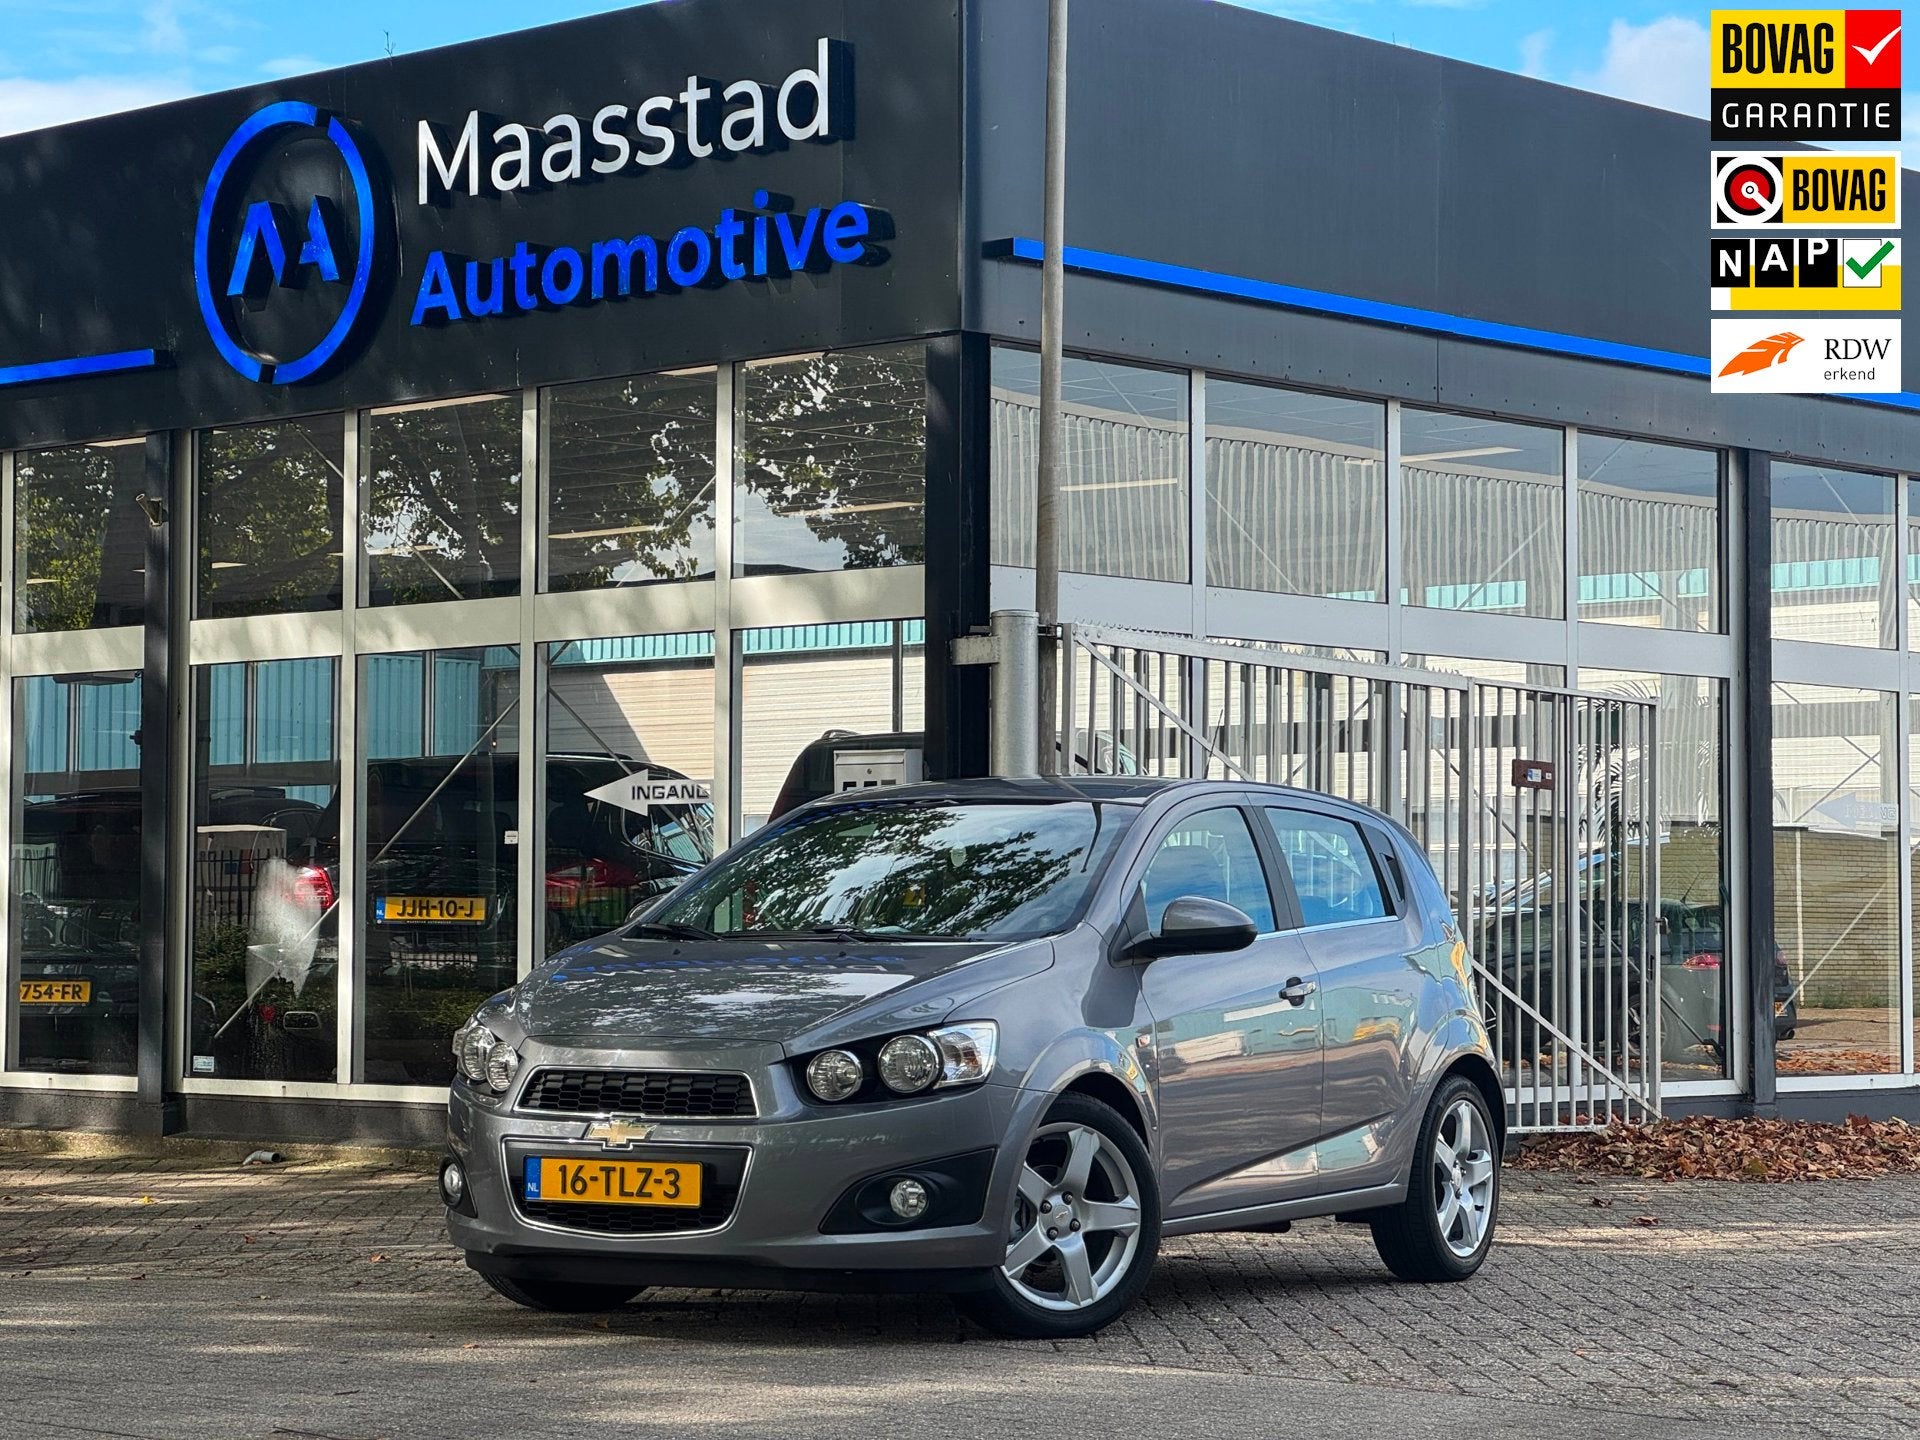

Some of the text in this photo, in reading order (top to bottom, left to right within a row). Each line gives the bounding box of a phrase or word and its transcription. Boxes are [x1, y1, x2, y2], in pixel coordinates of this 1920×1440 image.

[416, 36, 830, 205] Maasstad
[410, 188, 870, 326] Automotive
[396, 899, 474, 917] JJH-10-J
[20, 984, 82, 1000] 754-FR
[527, 1164, 681, 1199] NL 16-TLZ-3
